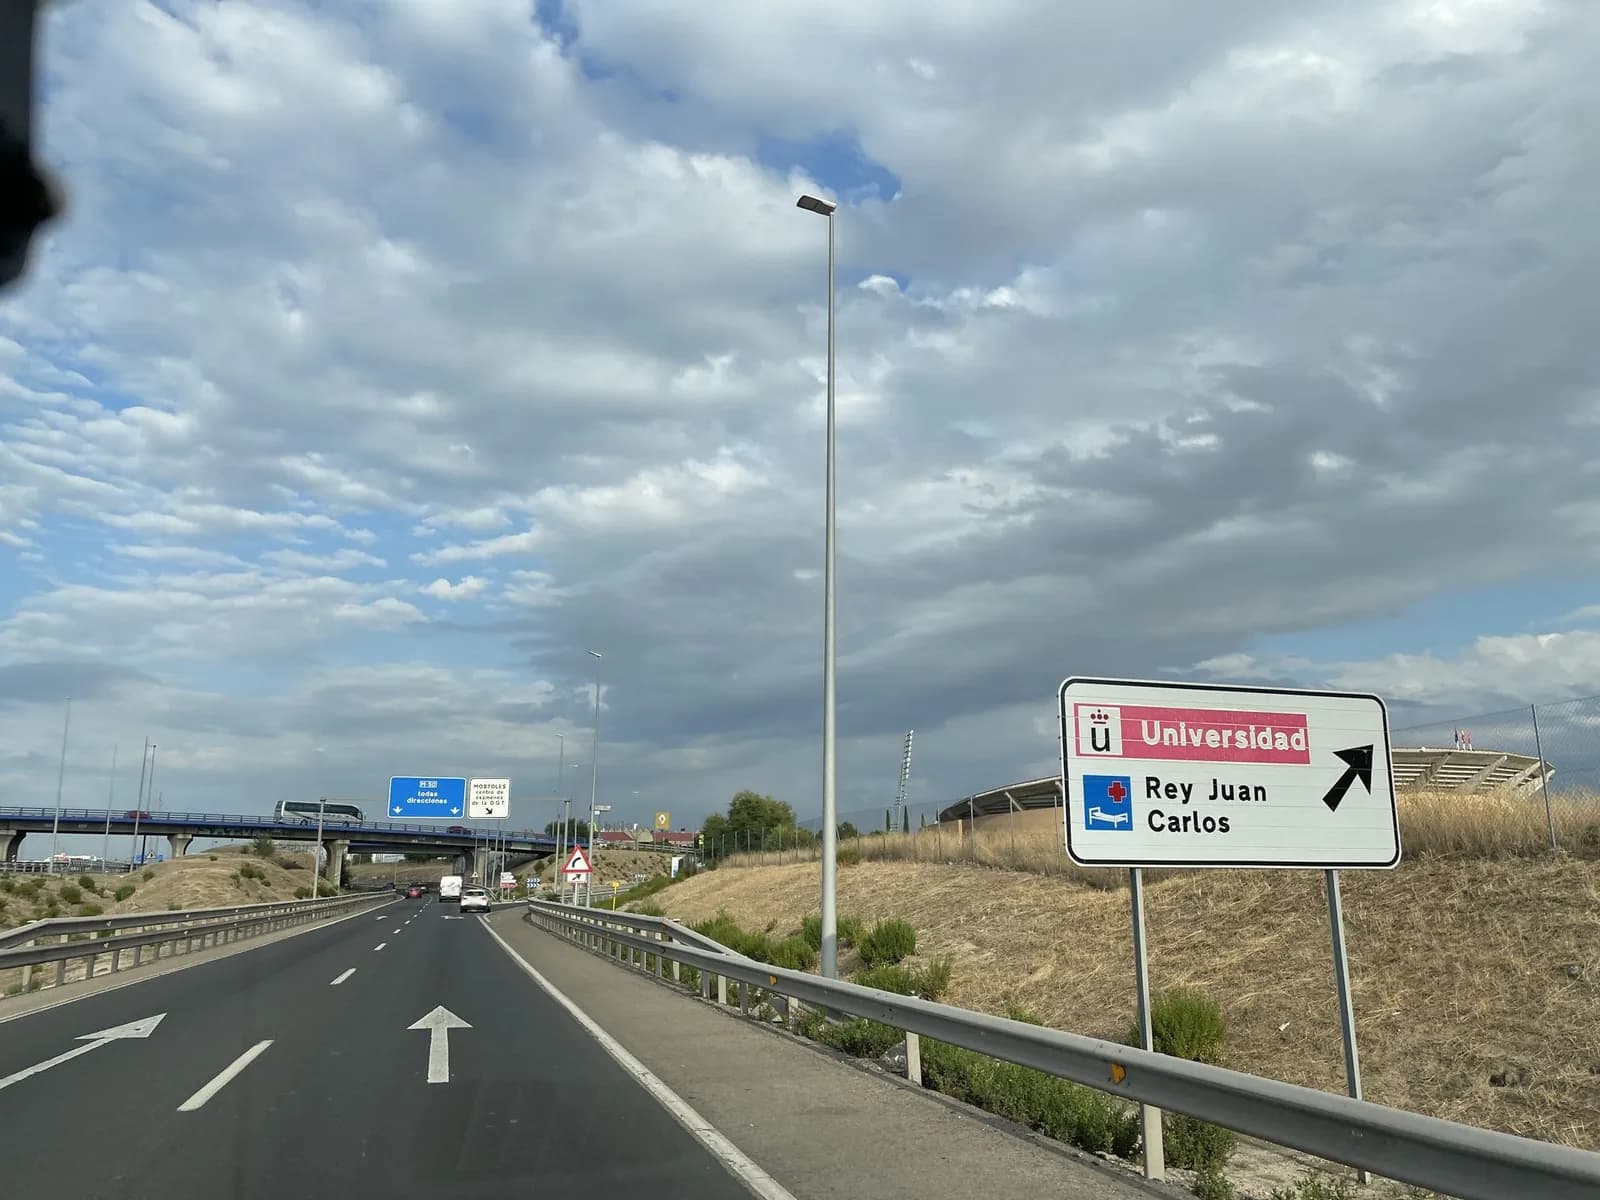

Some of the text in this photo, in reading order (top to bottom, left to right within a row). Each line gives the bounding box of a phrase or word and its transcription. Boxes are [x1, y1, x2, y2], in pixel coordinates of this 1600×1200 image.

[1141, 719, 1307, 751] Universidad
[1145, 776, 1267, 804] Rey Juan
[1147, 809, 1231, 833] Carlos
